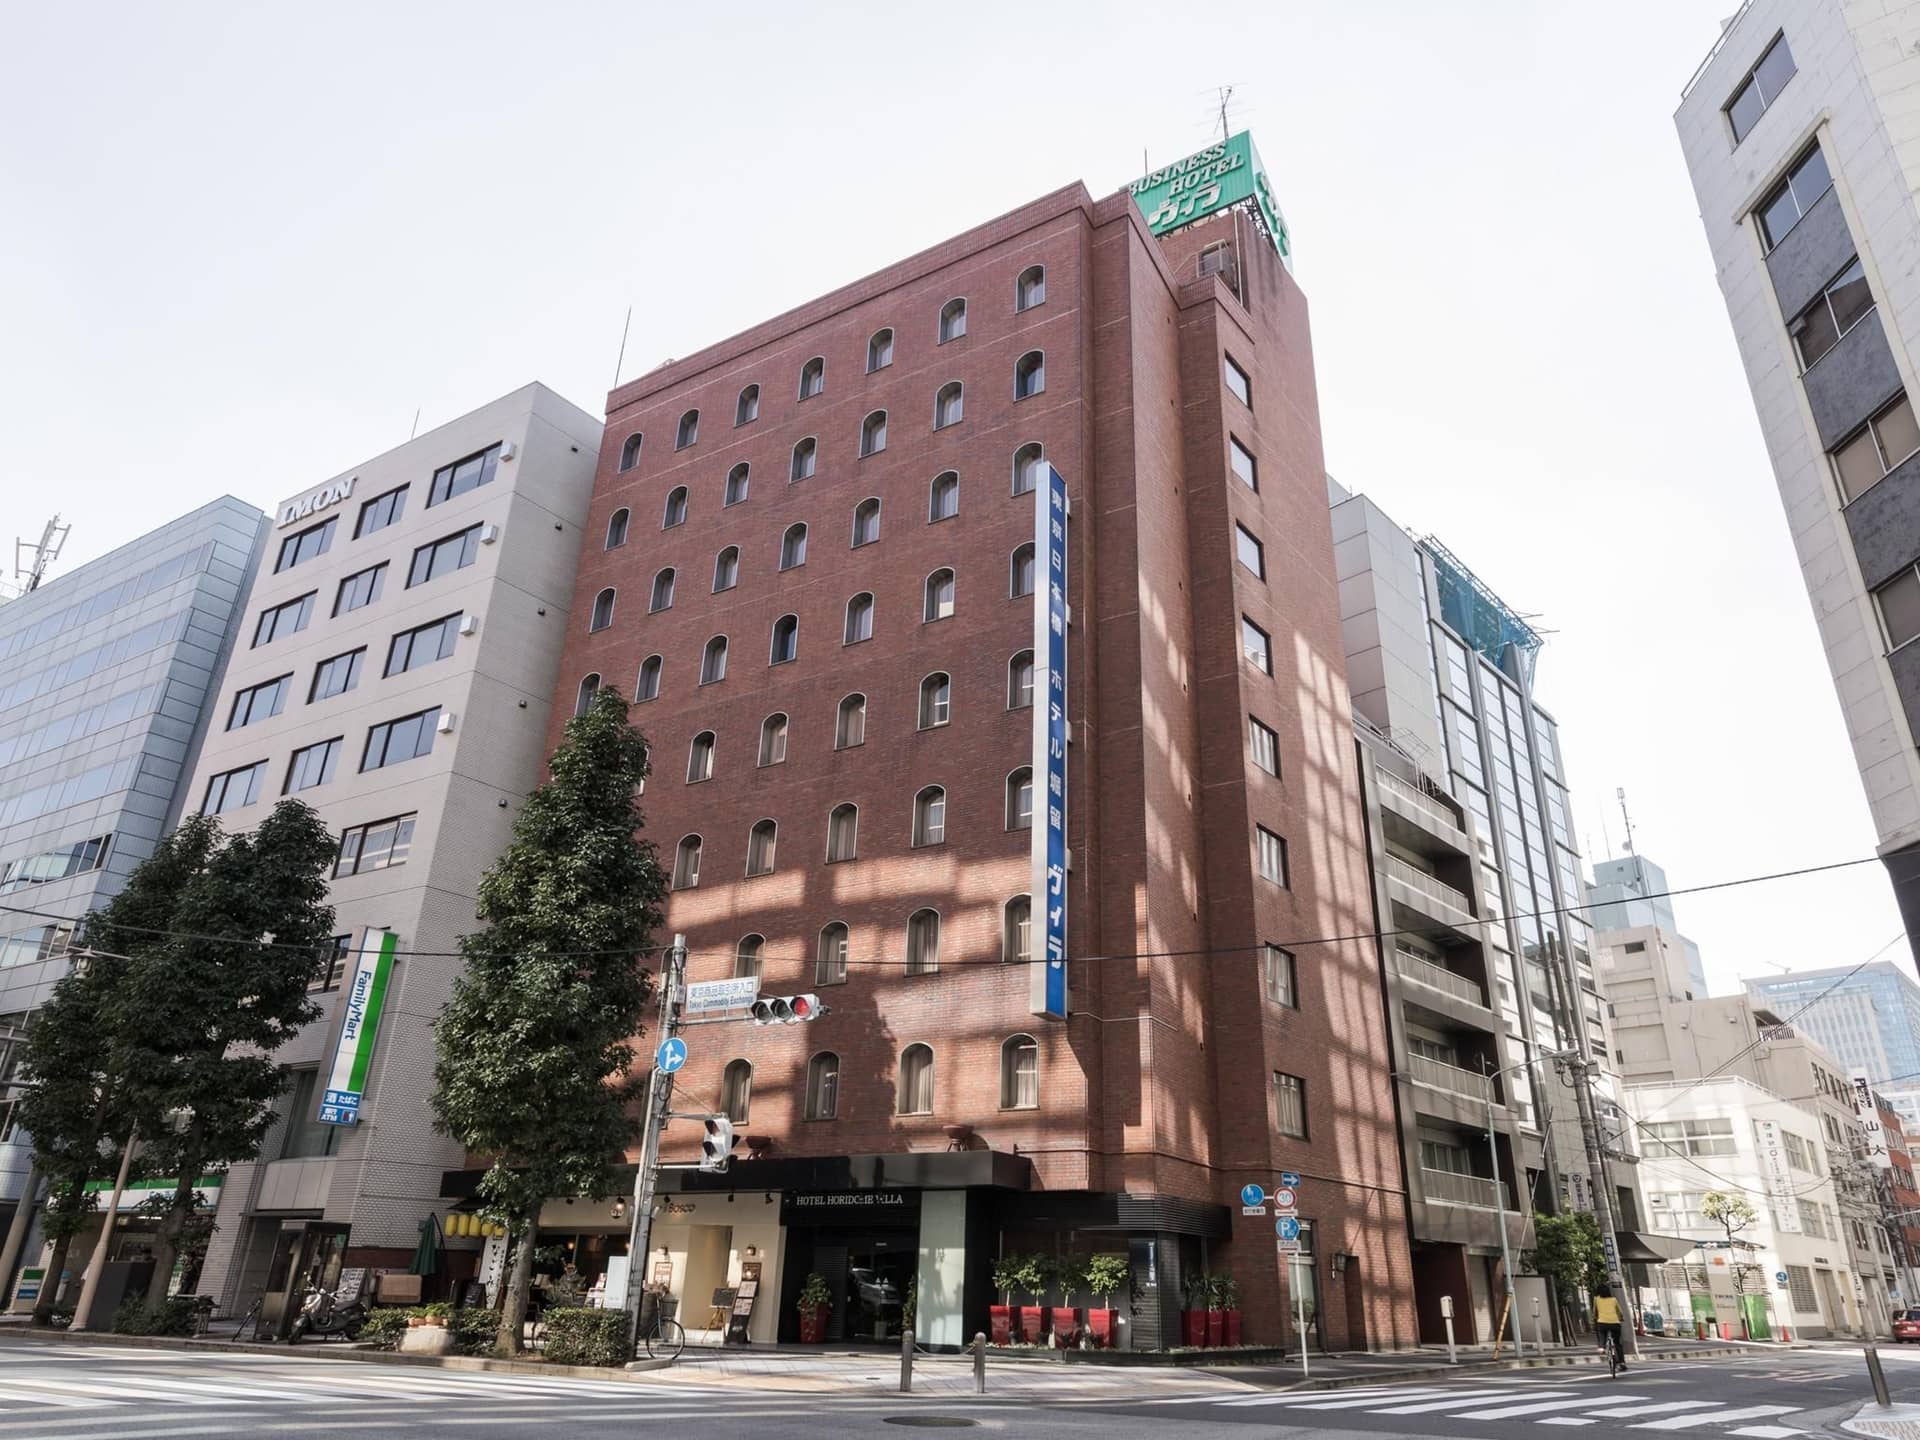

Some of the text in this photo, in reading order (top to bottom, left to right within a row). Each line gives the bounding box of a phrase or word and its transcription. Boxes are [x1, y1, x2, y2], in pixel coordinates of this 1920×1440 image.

[1128, 140, 1227, 197] BUSINESS
[1168, 151, 1245, 198] HOTEL
[1147, 180, 1222, 227] ヴィラ
[276, 475, 358, 529] IMON
[344, 970, 373, 1041] FamilyMart
[796, 1196, 825, 1206] HOTEL
